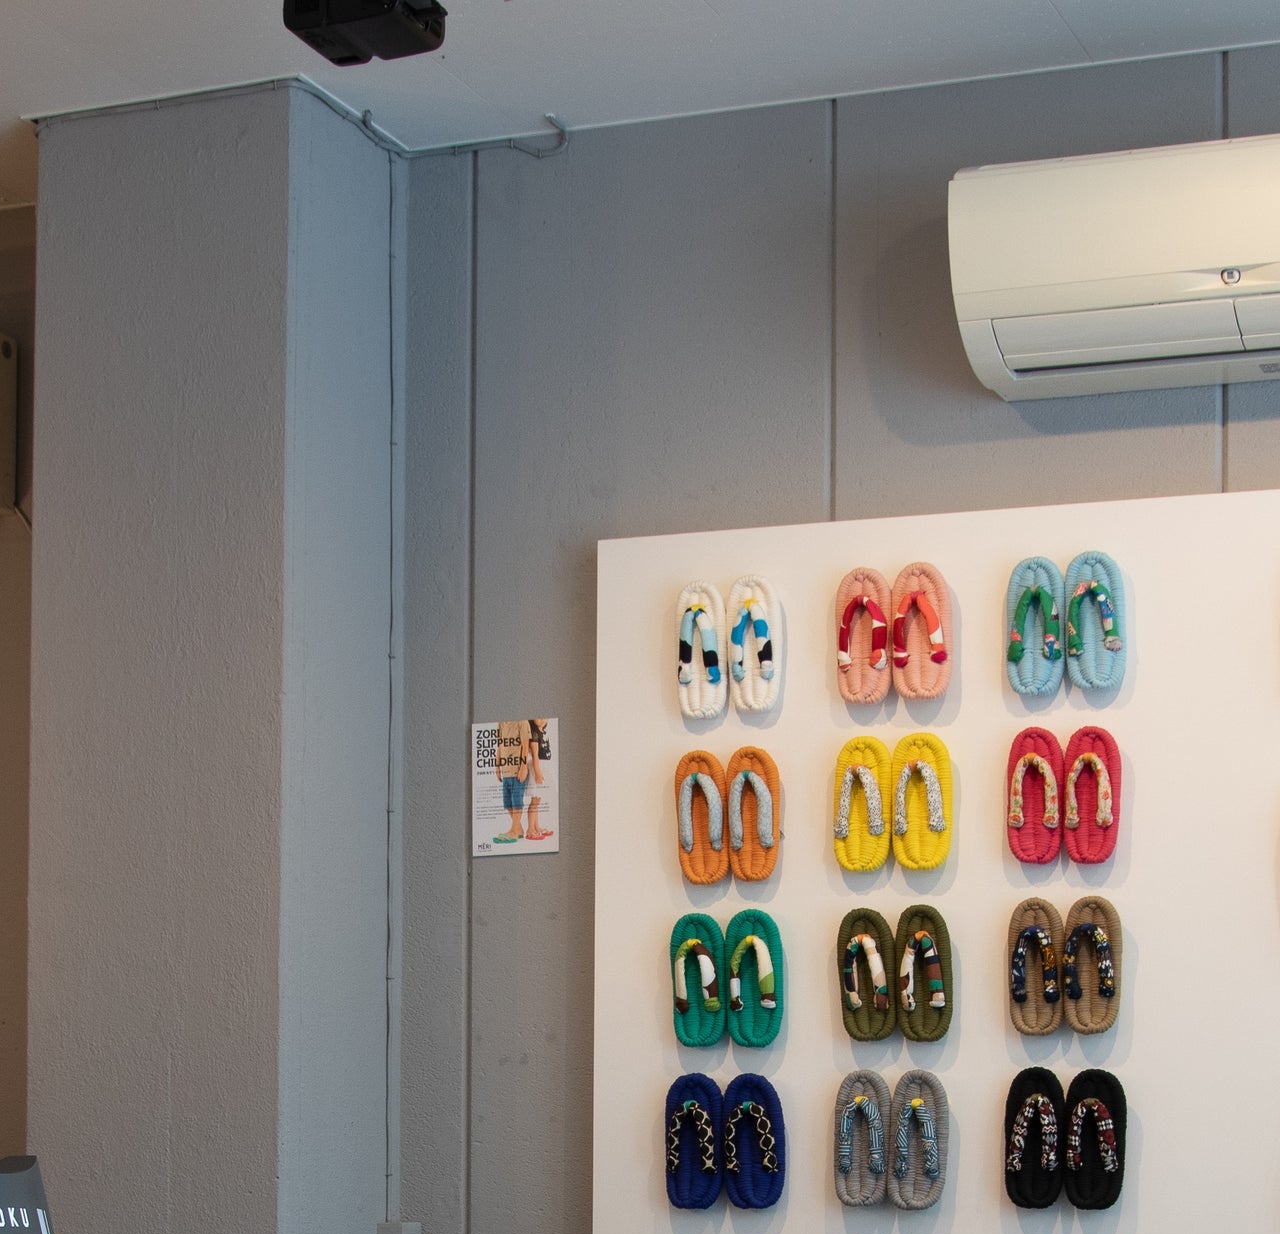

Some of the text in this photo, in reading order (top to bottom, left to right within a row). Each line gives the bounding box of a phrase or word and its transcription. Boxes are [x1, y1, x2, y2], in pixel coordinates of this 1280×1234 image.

[476, 729, 500, 739] ZORI
[476, 737, 521, 749] SLIPPERS
[477, 749, 496, 758] FOR
[477, 756, 527, 768] CHILDREN
